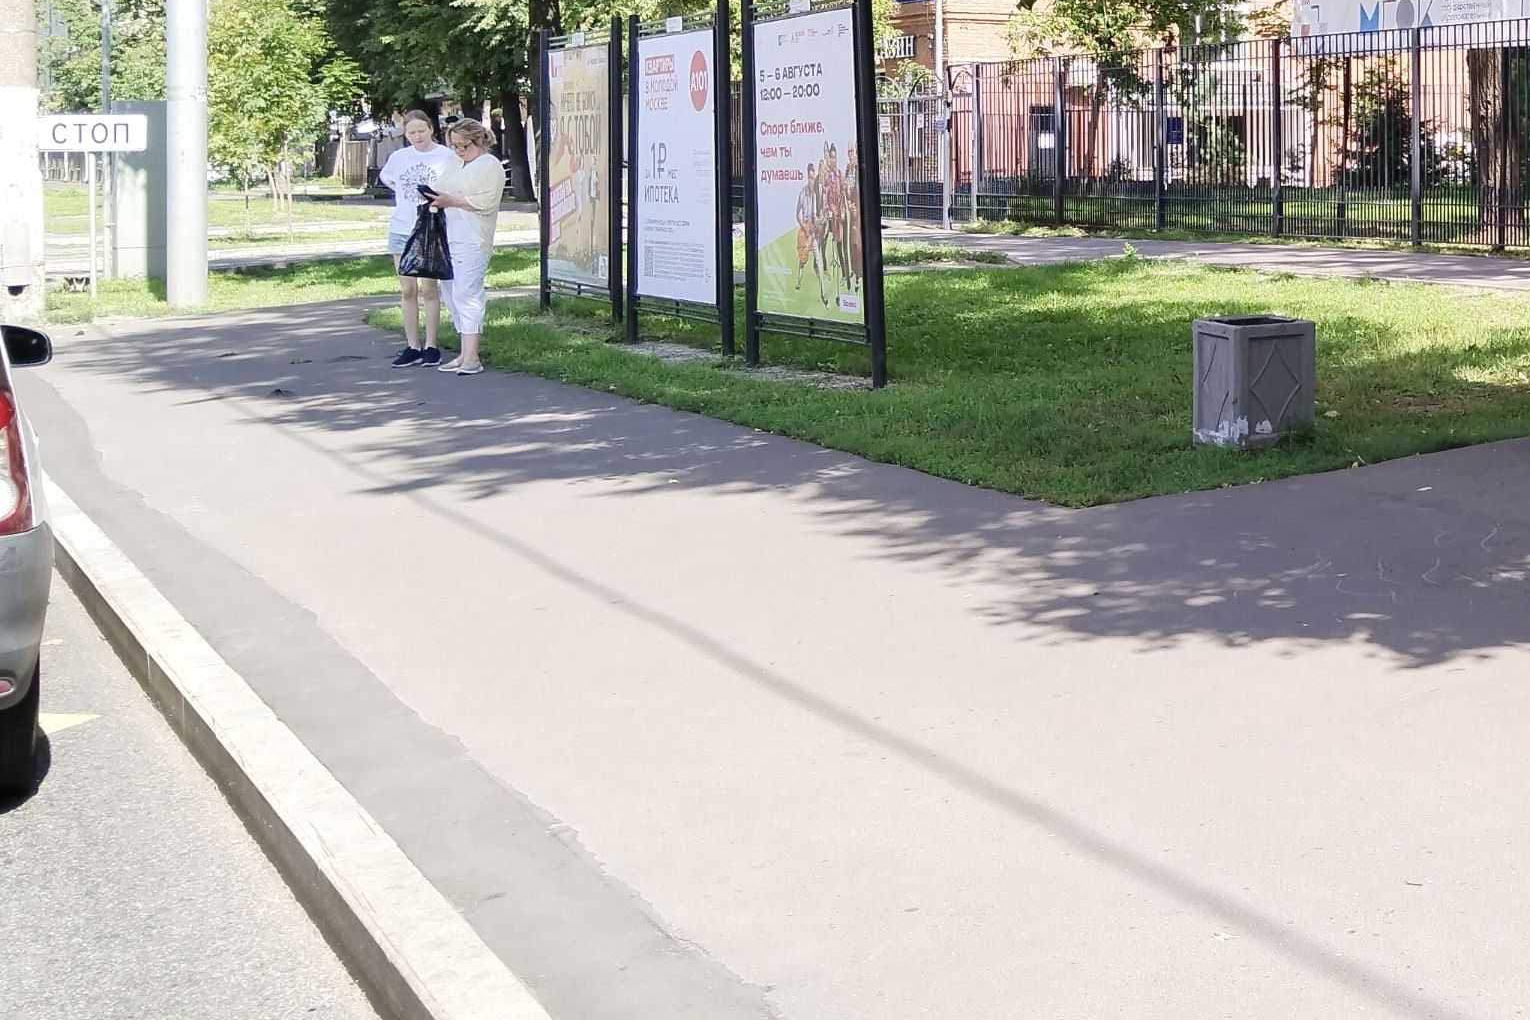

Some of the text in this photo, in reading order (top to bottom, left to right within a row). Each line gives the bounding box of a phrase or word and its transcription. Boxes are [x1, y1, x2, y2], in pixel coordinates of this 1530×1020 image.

[775, 68, 781, 81] 6
[782, 63, 822, 80] АВГУСТА
[760, 87, 782, 101] 12:00
[792, 83, 820, 98] 20:00
[52, 122, 129, 144] СТОП
[760, 119, 825, 139] Спорт ближе,
[760, 146, 792, 158] чем ты
[760, 169, 804, 184] думаешь
[644, 185, 679, 204] ИПОТЕКА
